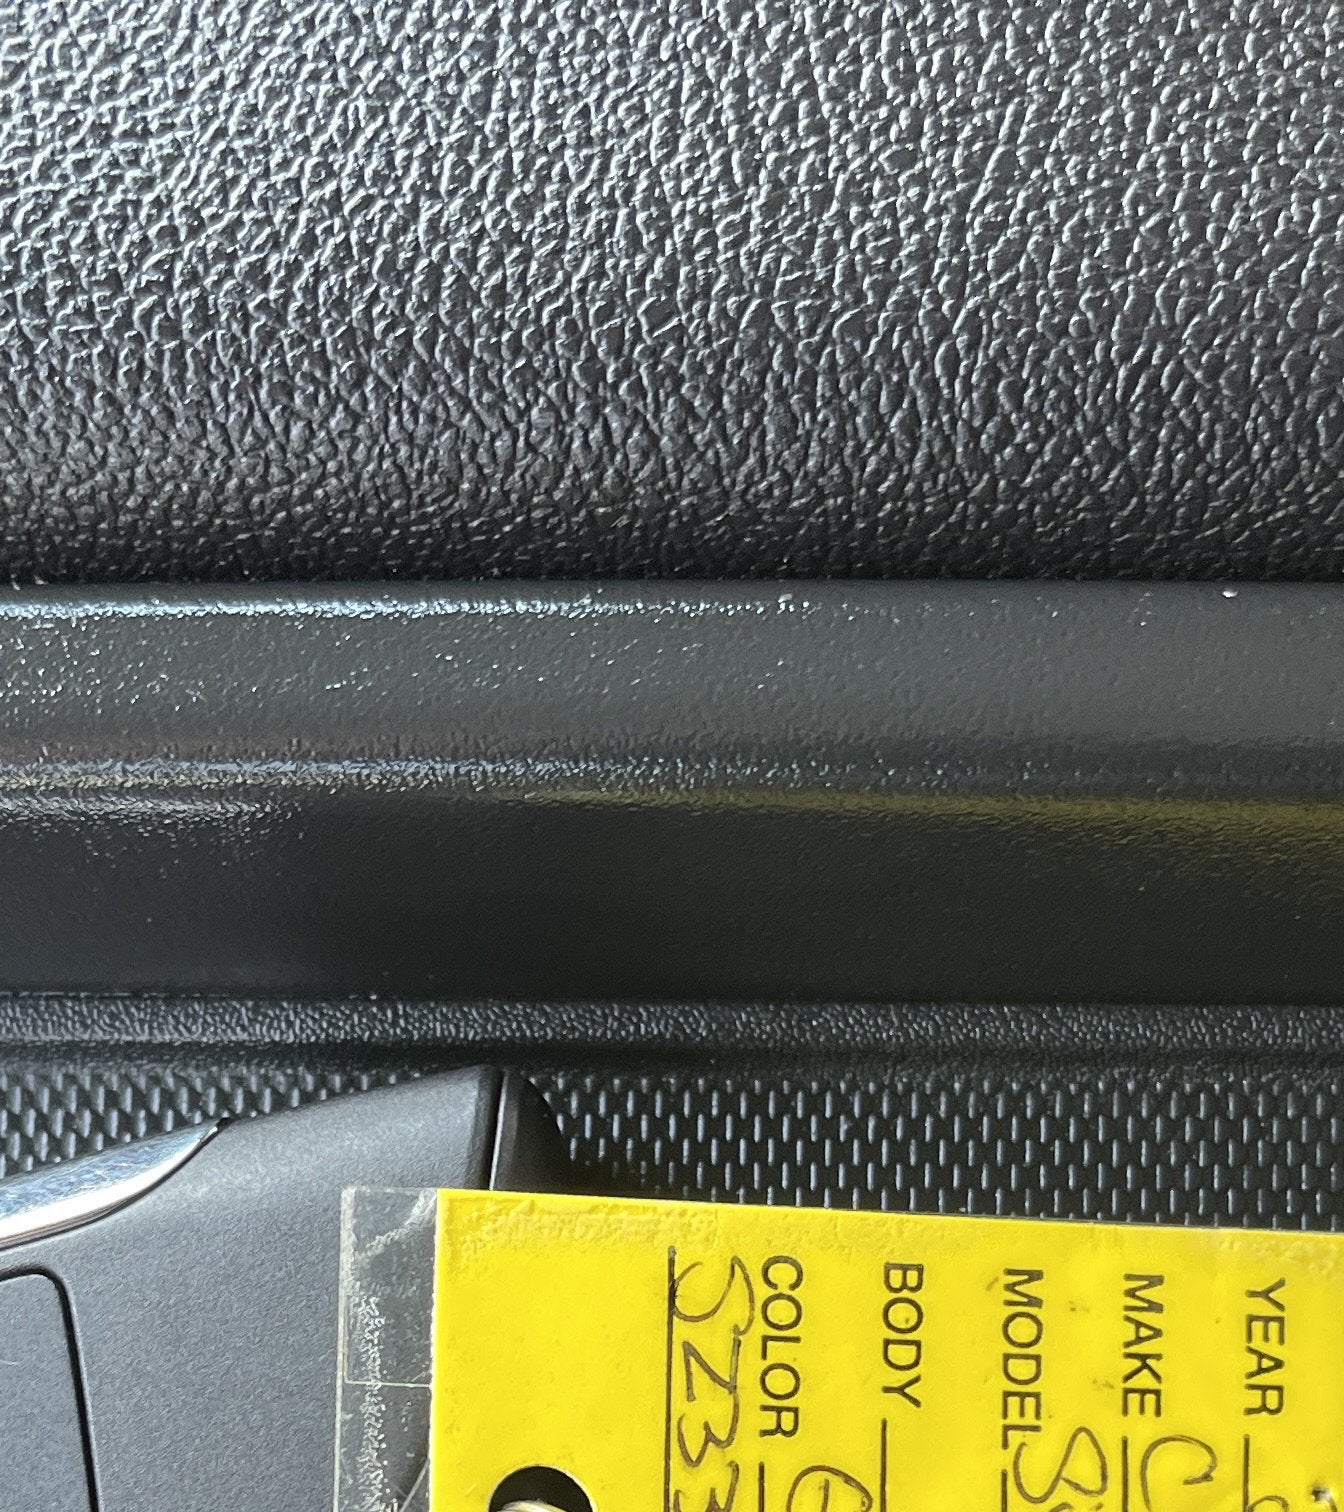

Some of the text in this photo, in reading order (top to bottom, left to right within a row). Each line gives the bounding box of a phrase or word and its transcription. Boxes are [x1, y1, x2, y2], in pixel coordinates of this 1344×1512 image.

[758, 1255, 804, 1438] COLOR
[882, 1262, 924, 1408] BODY
[1001, 1268, 1044, 1450] MODEL
[1122, 1274, 1164, 1418] MAKE
[1244, 1278, 1285, 1417] YEAR
